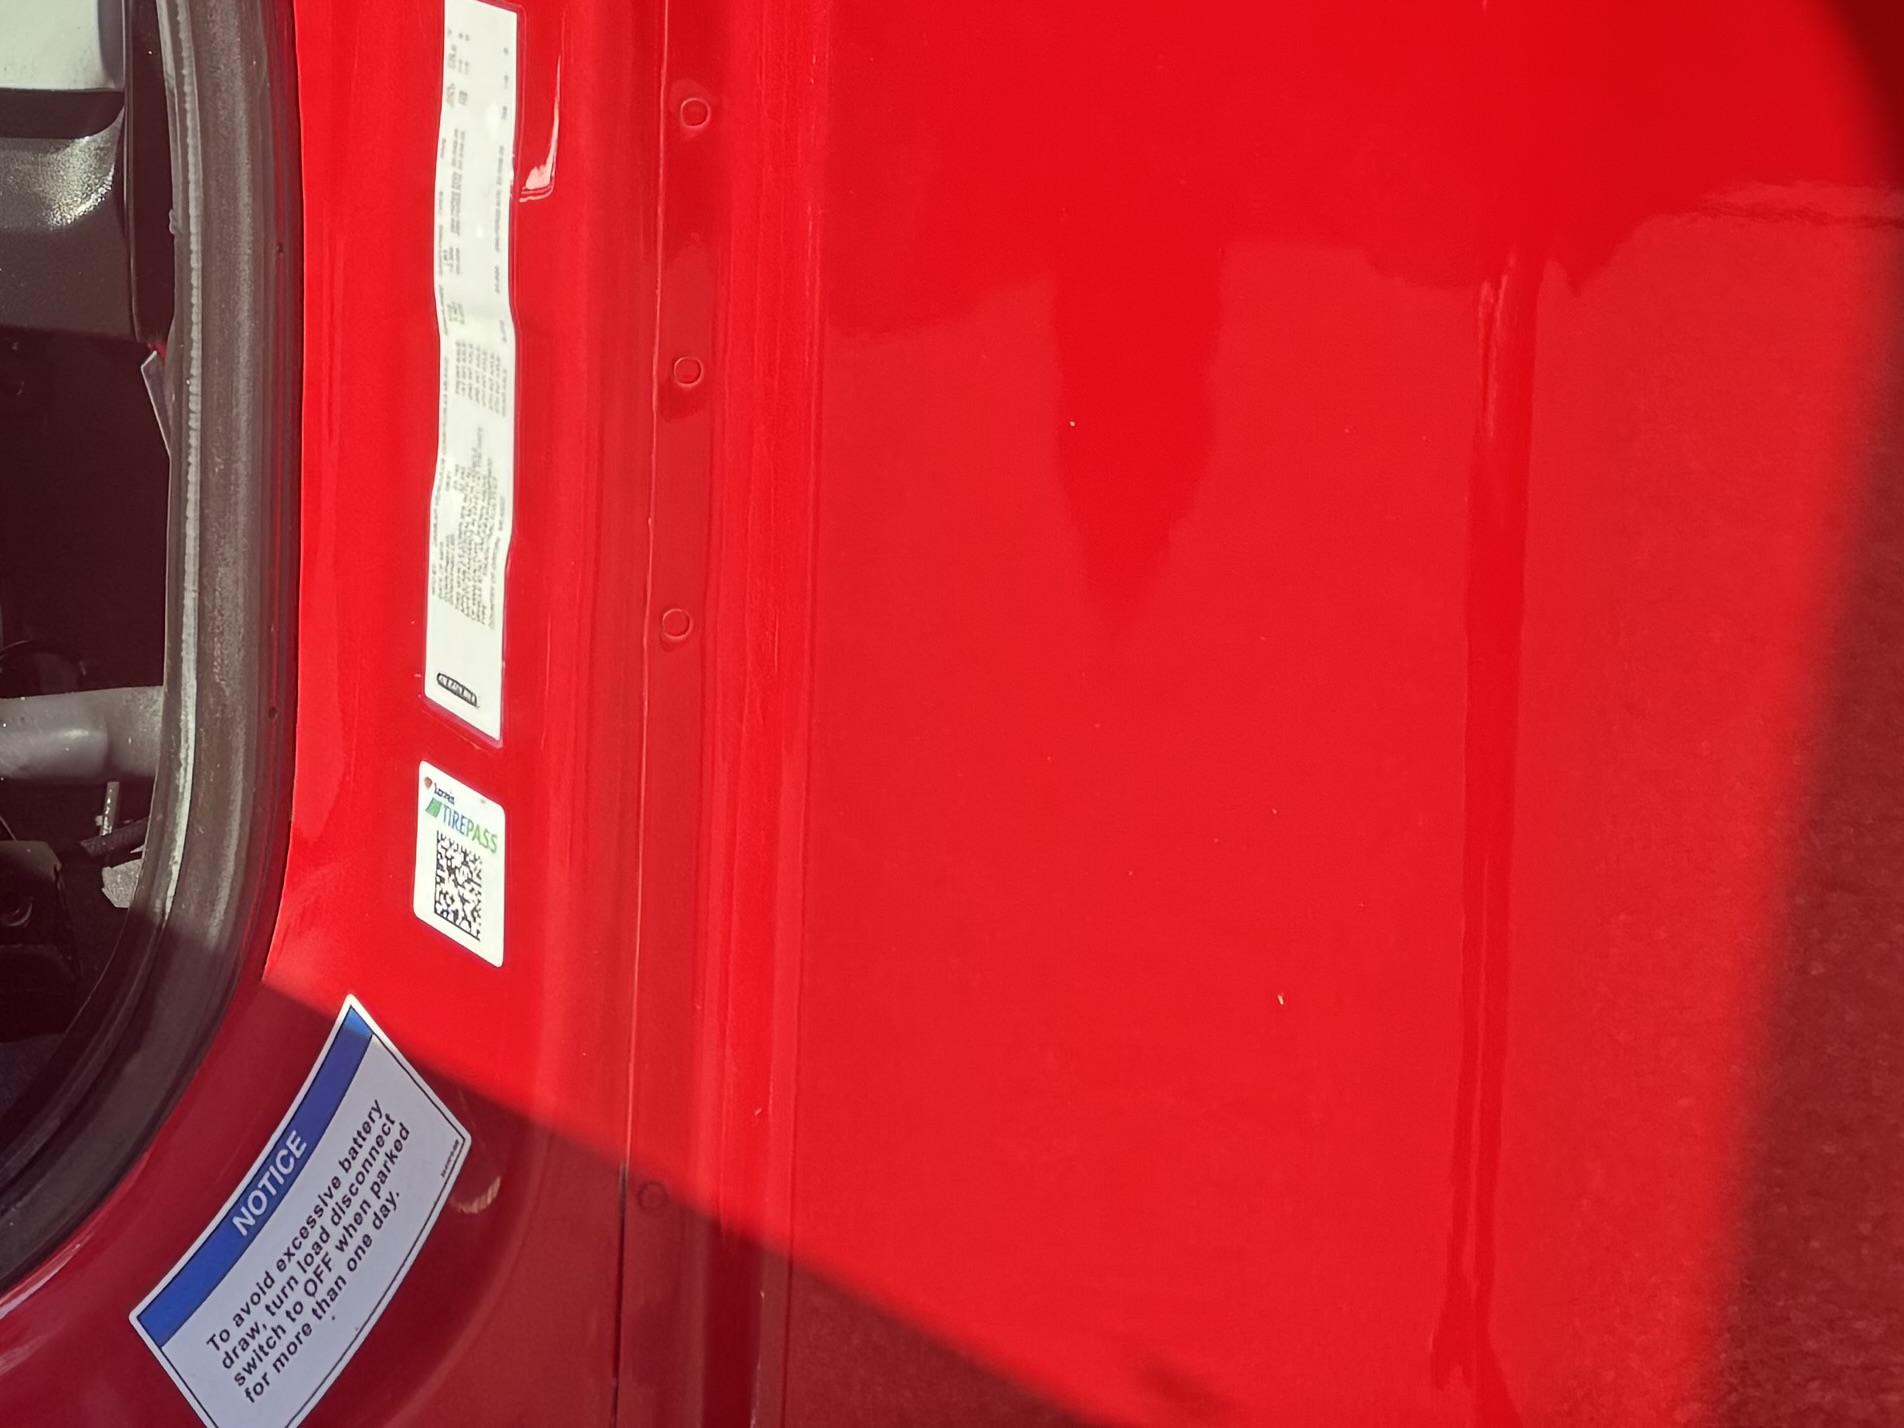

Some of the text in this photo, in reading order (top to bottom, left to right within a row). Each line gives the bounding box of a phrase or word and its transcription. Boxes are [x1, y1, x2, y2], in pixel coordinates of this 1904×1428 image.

[443, 803, 498, 853] TIREPASS
[206, 1099, 383, 1353] To avoid excessive battery
[221, 1112, 396, 1370] draw, turn load disconnect
[232, 1130, 308, 1236] NOTICE
[234, 1122, 411, 1386] switch to OFF when parked
[244, 1191, 400, 1404] for more than one day.
